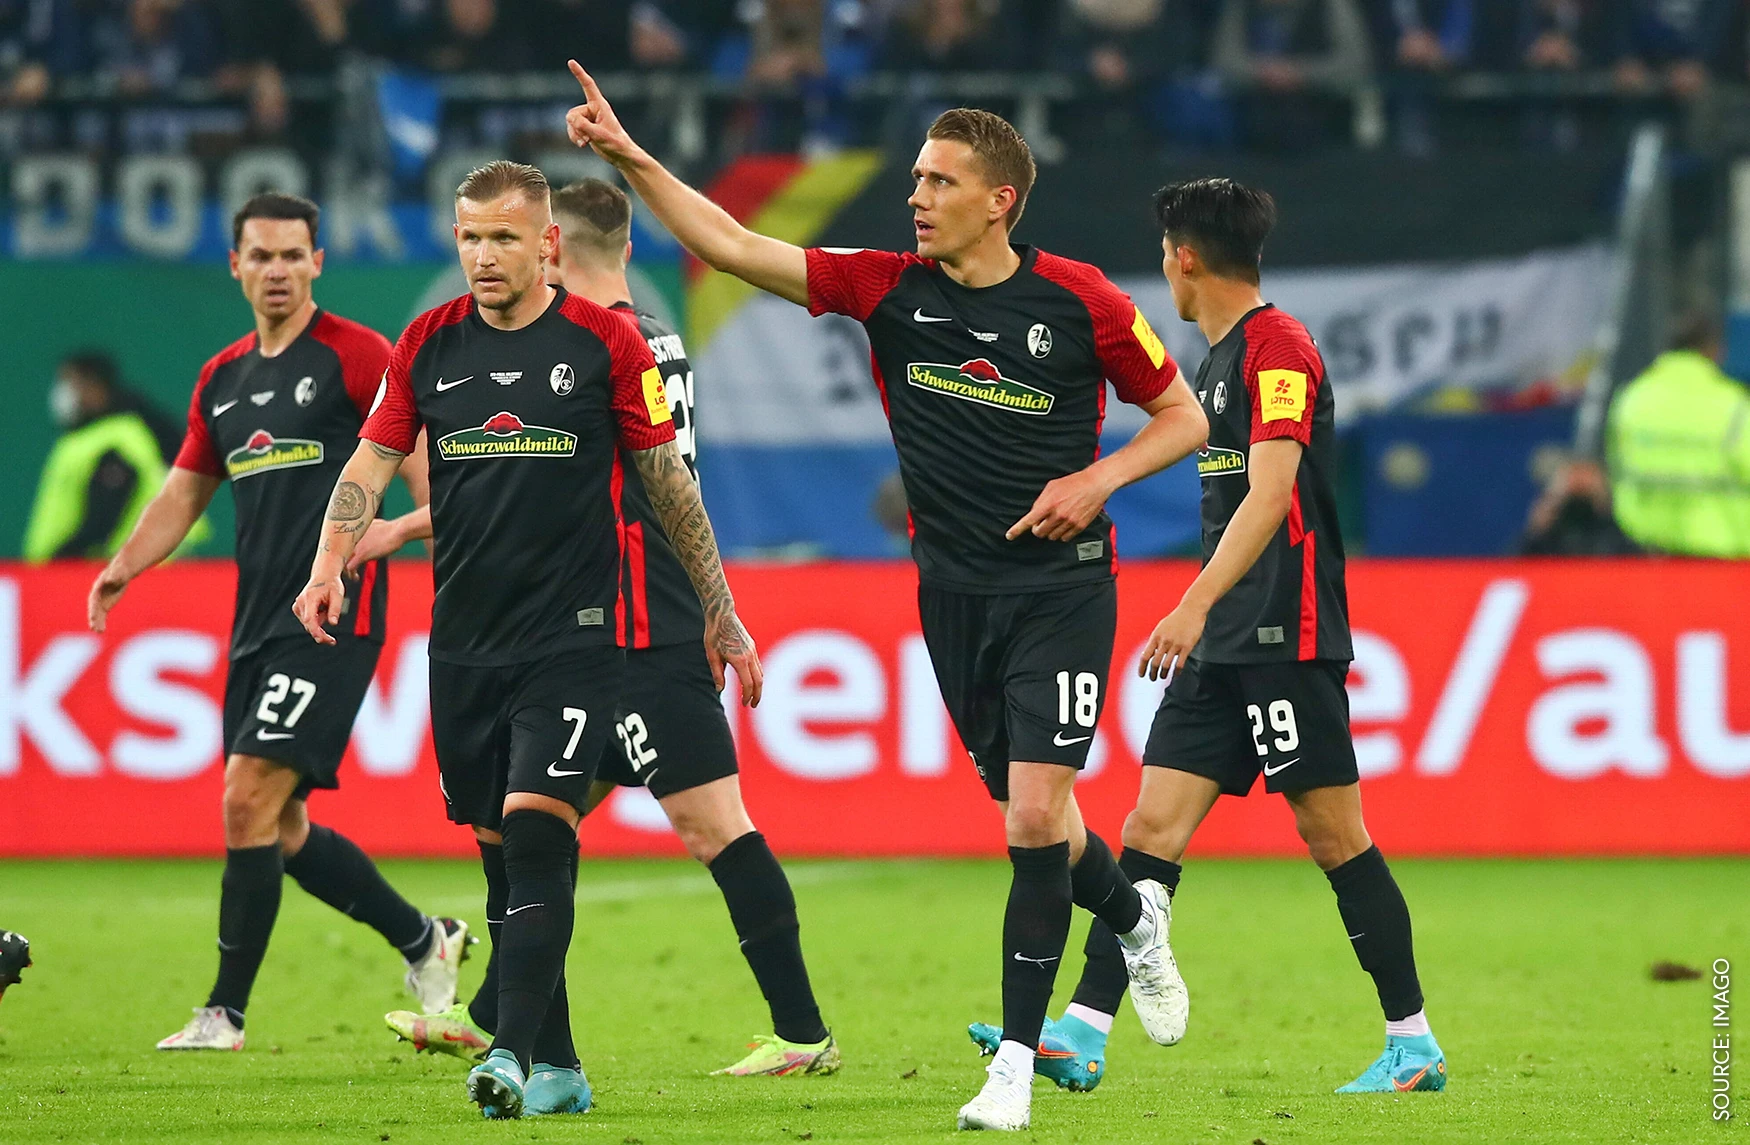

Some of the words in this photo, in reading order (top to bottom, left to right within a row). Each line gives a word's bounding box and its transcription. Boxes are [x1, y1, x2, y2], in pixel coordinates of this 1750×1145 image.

[910, 365, 1050, 410] Schwarzwaldmilch
[1270, 396, 1295, 406] LOTTO
[440, 436, 574, 456] Schwarzwaldmilch
[256, 673, 316, 728] 27
[1056, 671, 1099, 728] 18
[562, 707, 588, 760] 7
[615, 712, 659, 772] 22
[1247, 699, 1299, 756] 29
